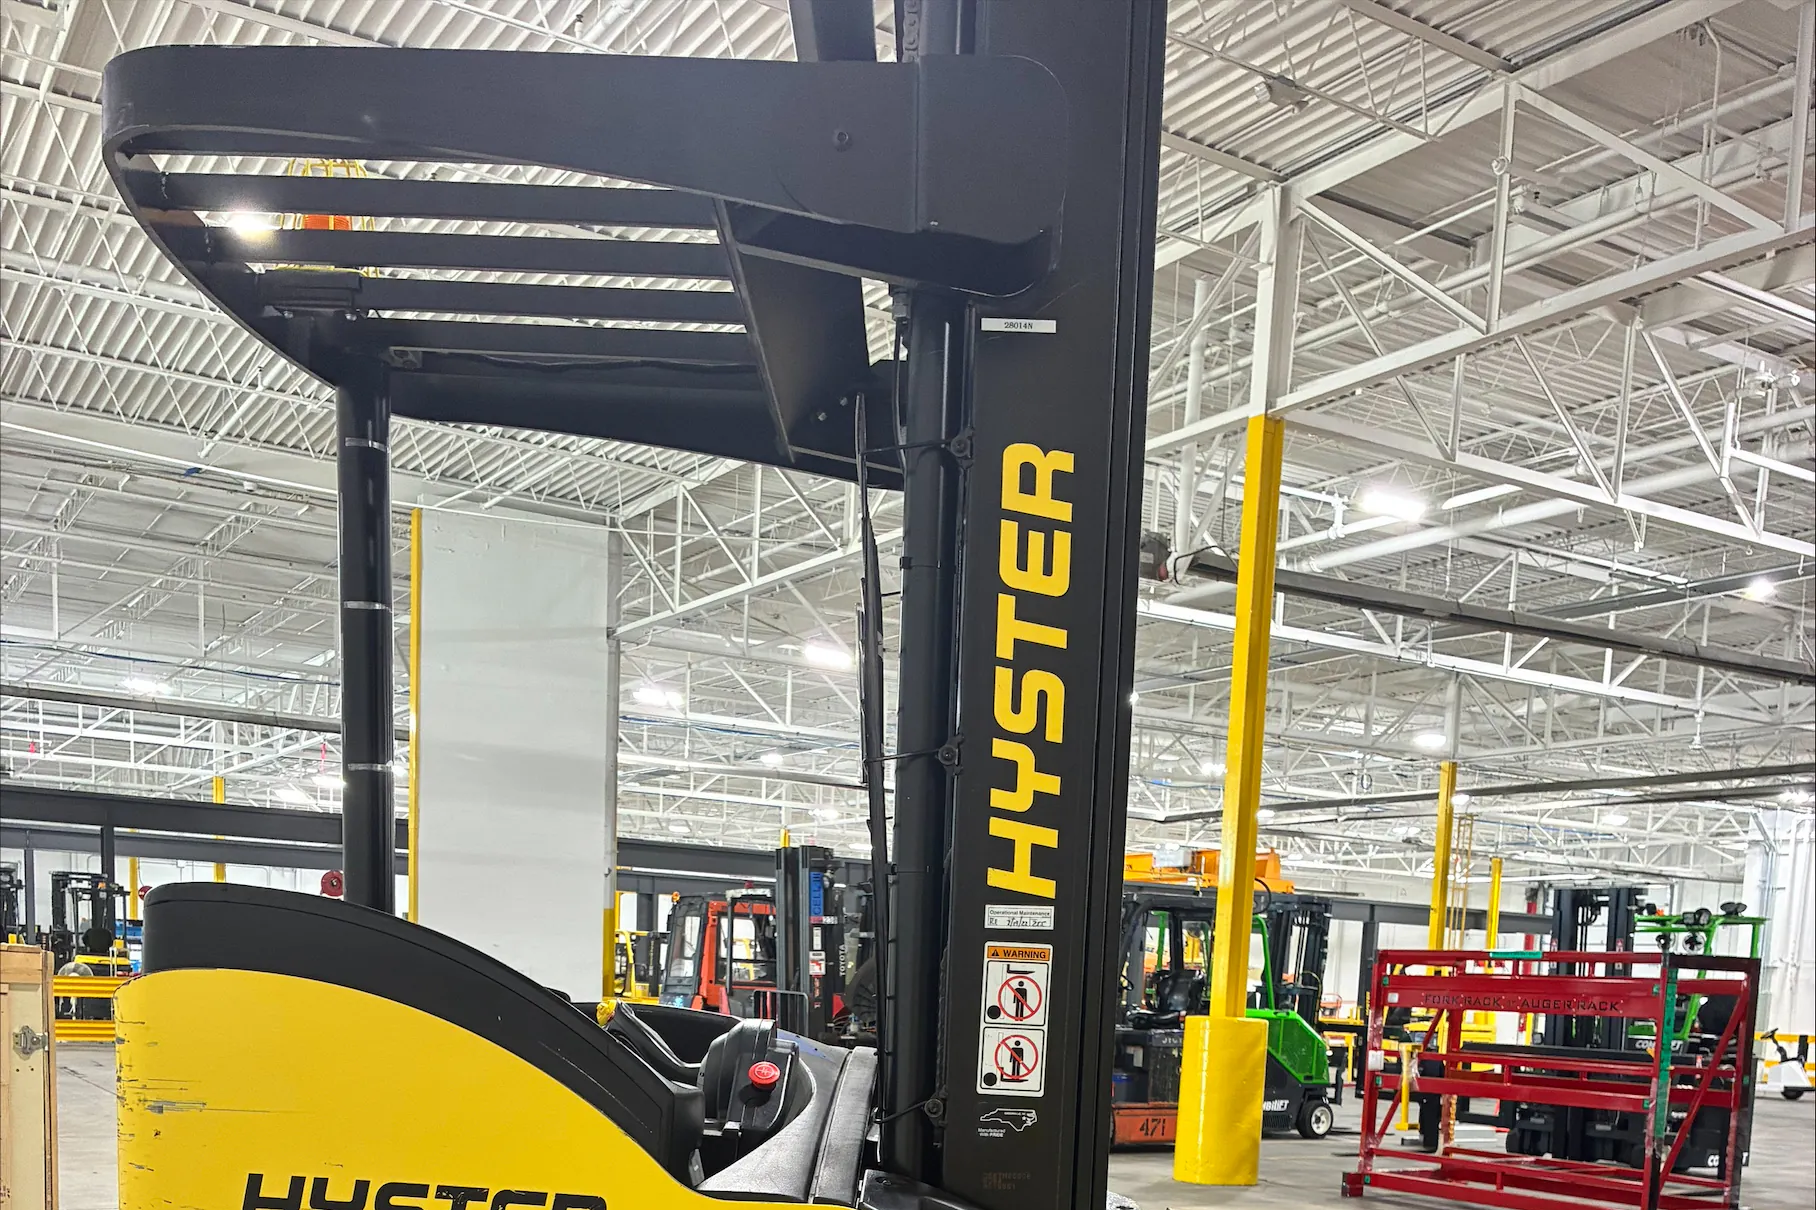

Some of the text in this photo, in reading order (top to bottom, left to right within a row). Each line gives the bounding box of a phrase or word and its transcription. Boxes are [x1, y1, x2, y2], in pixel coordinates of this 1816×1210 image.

[1004, 322, 1033, 330] 28014N
[987, 442, 1075, 899] HYSTER
[839, 944, 847, 976] TOYOTA
[1003, 950, 1046, 958] WARNING
[1464, 996, 1500, 1007] RACK
[1522, 999, 1572, 1010] AUGER
[1577, 1000, 1619, 1011] RACK
[1140, 1118, 1166, 1136] 471
